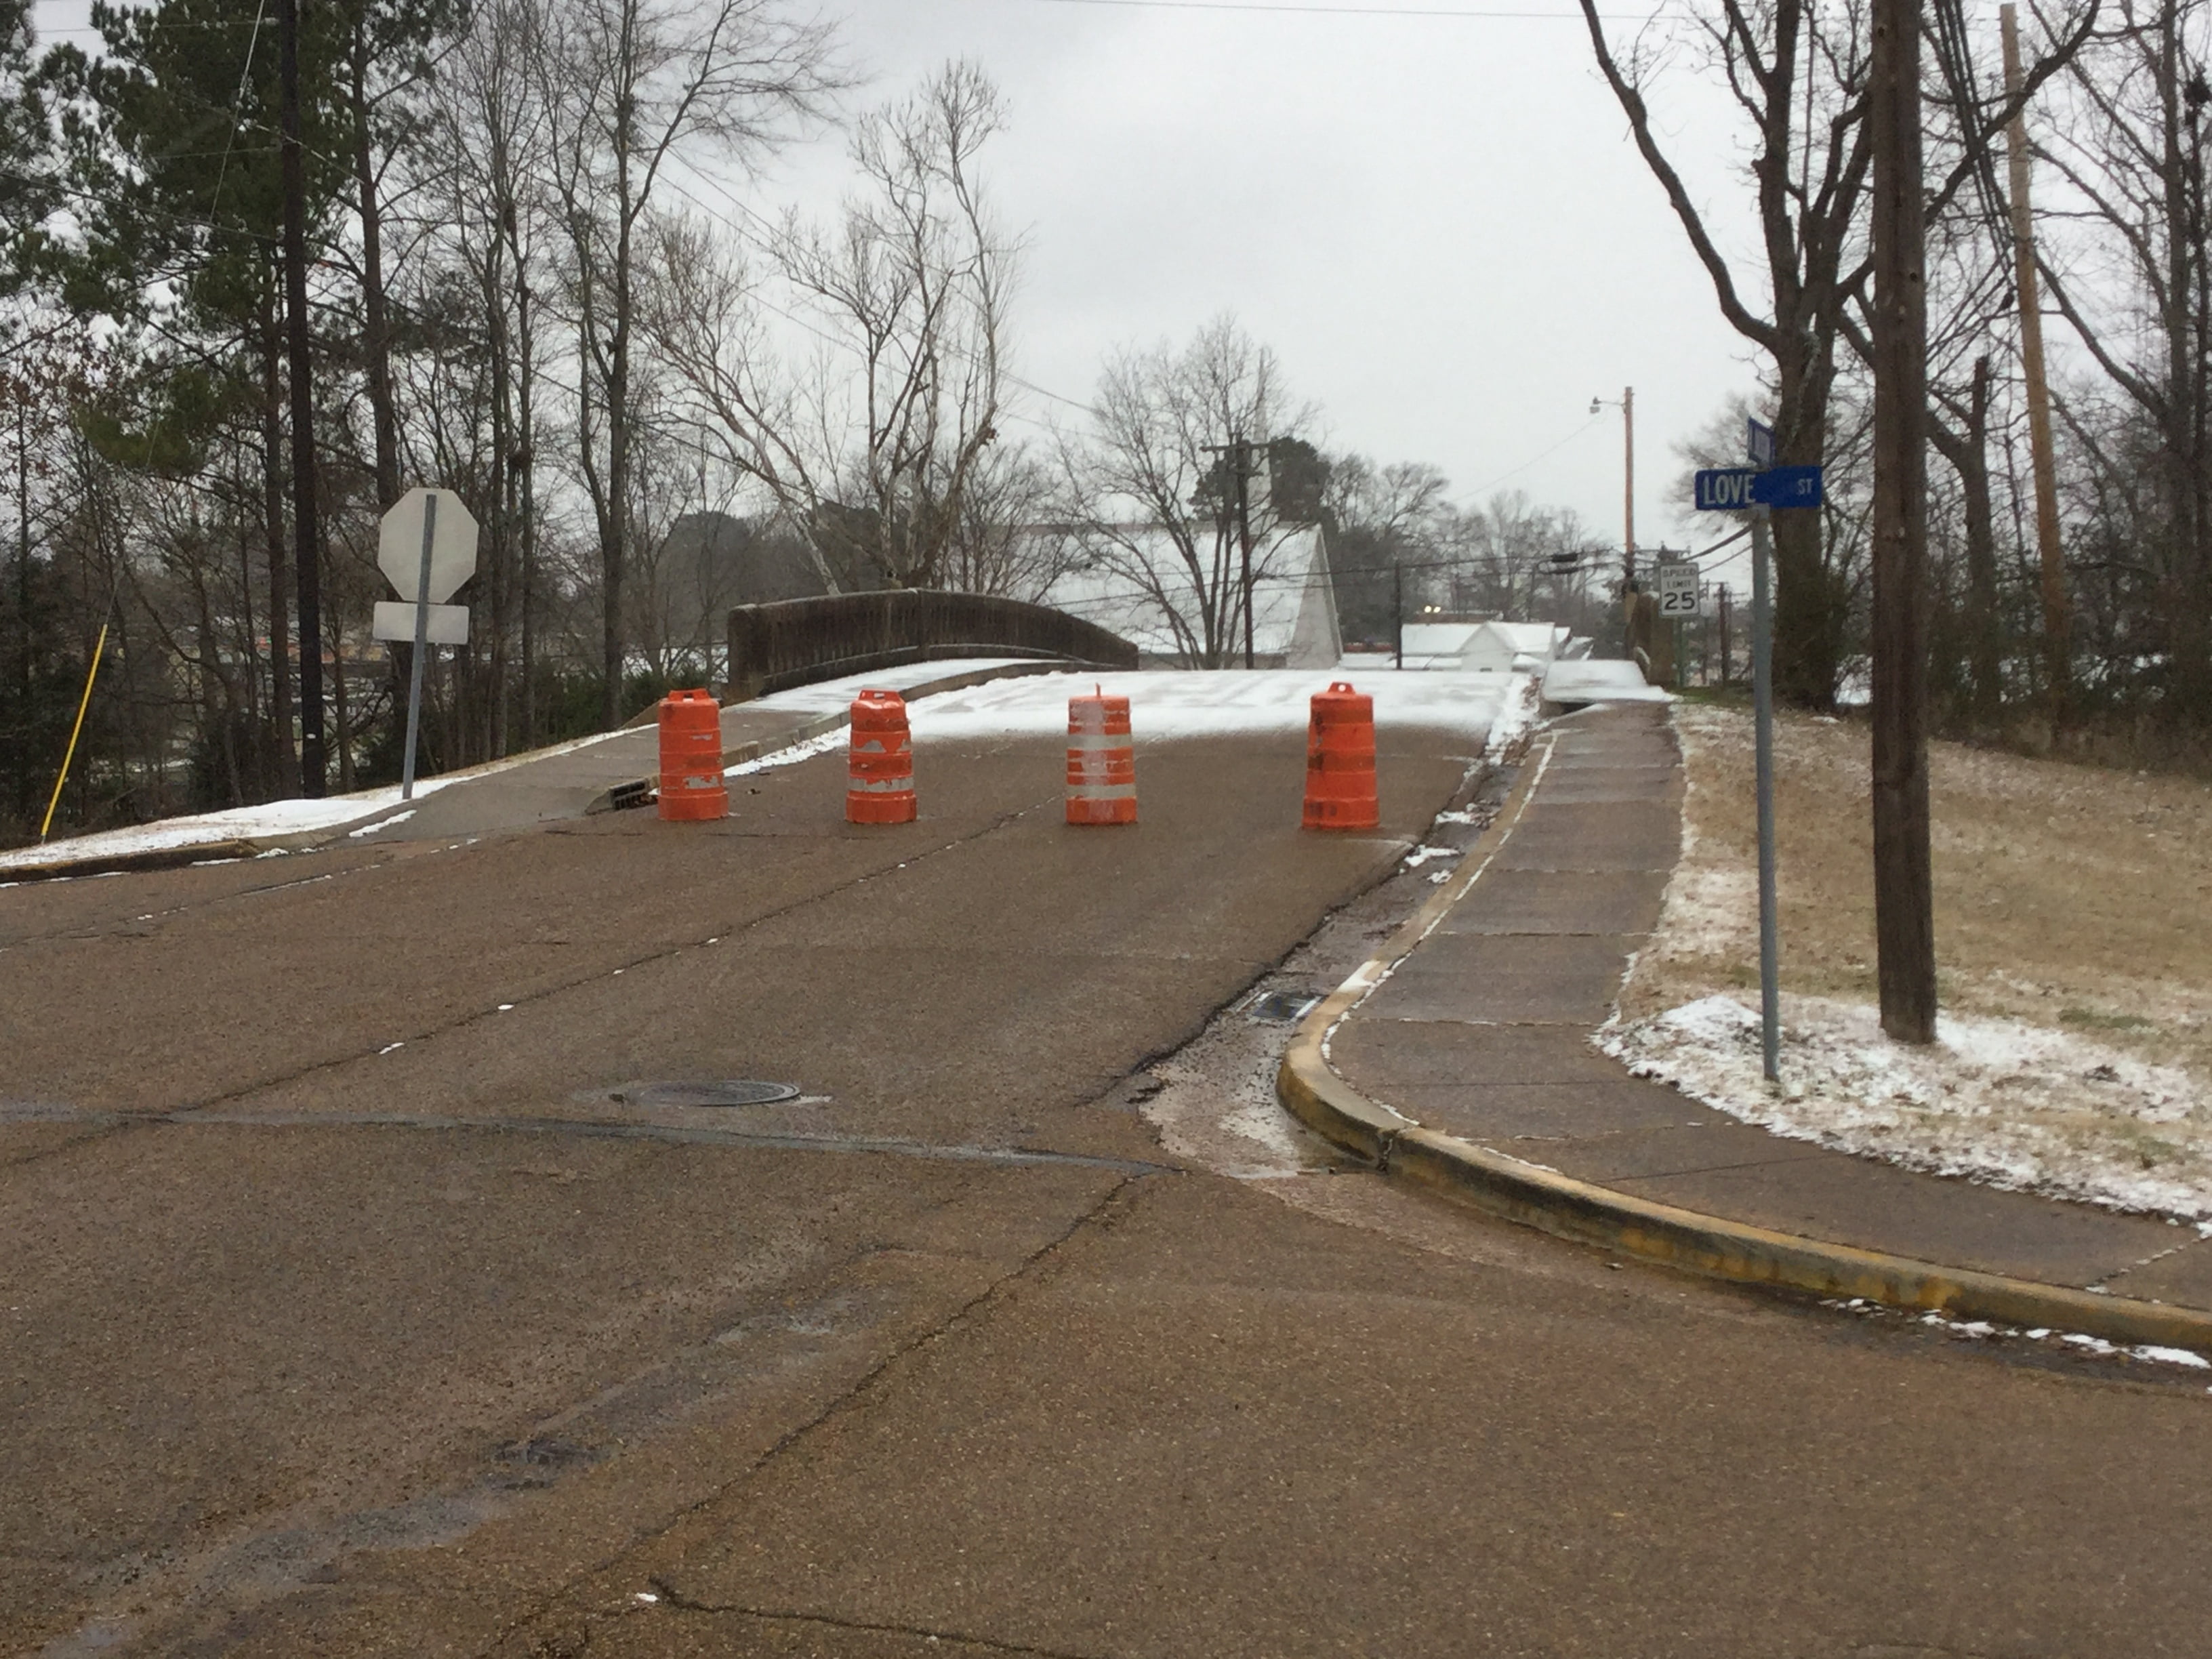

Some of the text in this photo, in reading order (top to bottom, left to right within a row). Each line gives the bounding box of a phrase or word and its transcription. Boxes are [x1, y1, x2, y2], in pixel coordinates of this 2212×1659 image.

[1703, 474, 1813, 504] LOVE ST
[1664, 591, 1695, 609] 25
